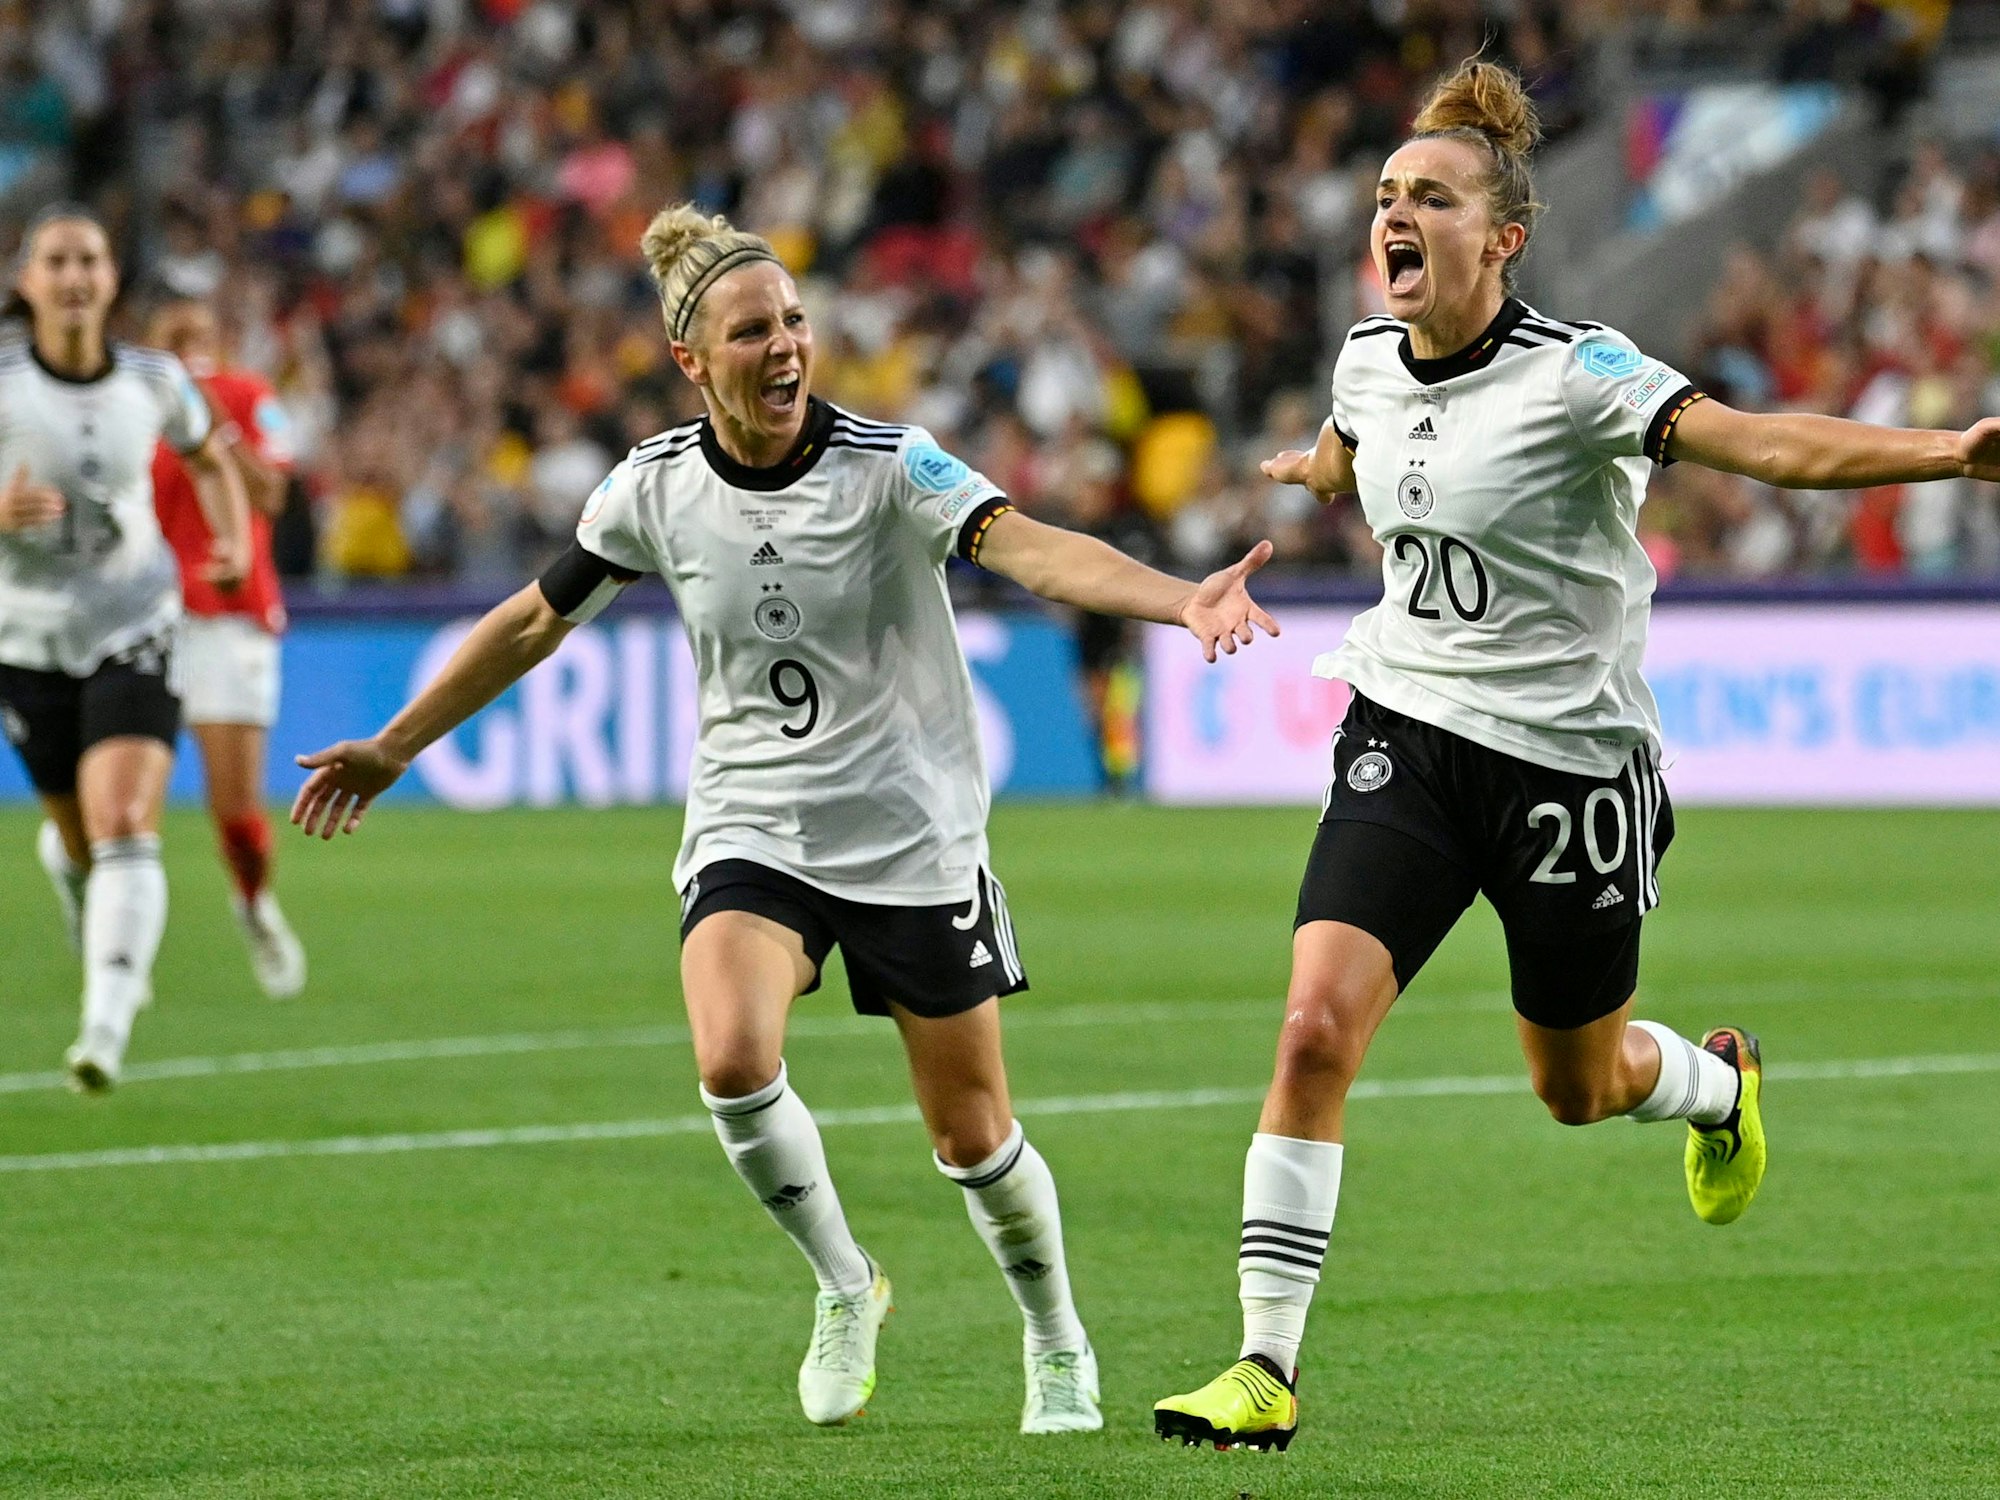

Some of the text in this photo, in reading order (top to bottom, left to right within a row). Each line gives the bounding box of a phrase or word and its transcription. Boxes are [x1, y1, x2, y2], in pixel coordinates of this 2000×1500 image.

[1408, 431, 1438, 441] adidas
[749, 556, 784, 566] adidas
[1394, 534, 1488, 622] 20
[769, 658, 819, 739] 9
[1527, 787, 1628, 884] 20
[1592, 894, 1625, 910] adidas
